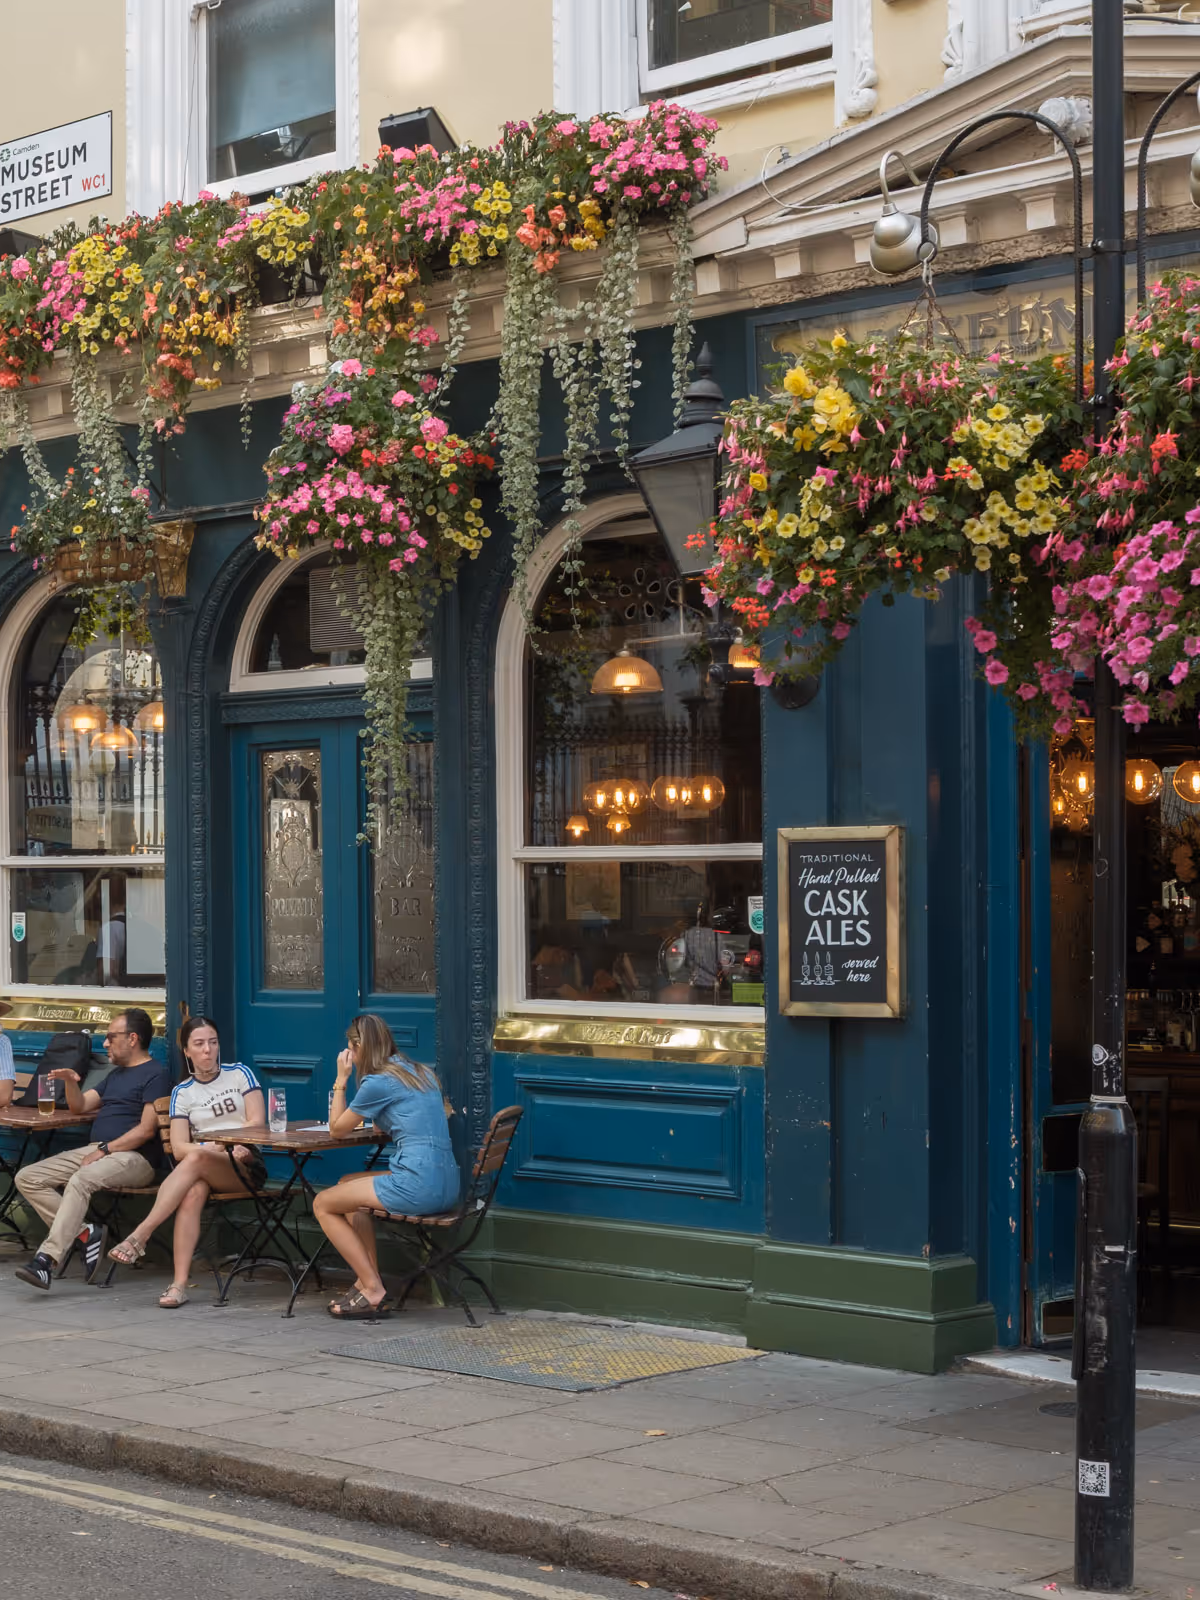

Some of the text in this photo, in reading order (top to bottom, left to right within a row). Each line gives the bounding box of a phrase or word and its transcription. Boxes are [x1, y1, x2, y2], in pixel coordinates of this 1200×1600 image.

[12, 143, 40, 156] Camden
[1, 142, 87, 186] MUSEUM
[0, 173, 106, 214] STREET WC1
[800, 853, 874, 863] TRADITIONAL
[798, 866, 881, 888] Hand Pulled
[271, 897, 317, 917] PRIVATE
[390, 897, 423, 917] BAR
[803, 889, 870, 917] CASK
[804, 919, 872, 947] ALES
[841, 956, 879, 969] served
[846, 969, 872, 983] here
[35, 1005, 75, 1020] Museum
[211, 1098, 237, 1117] 08
